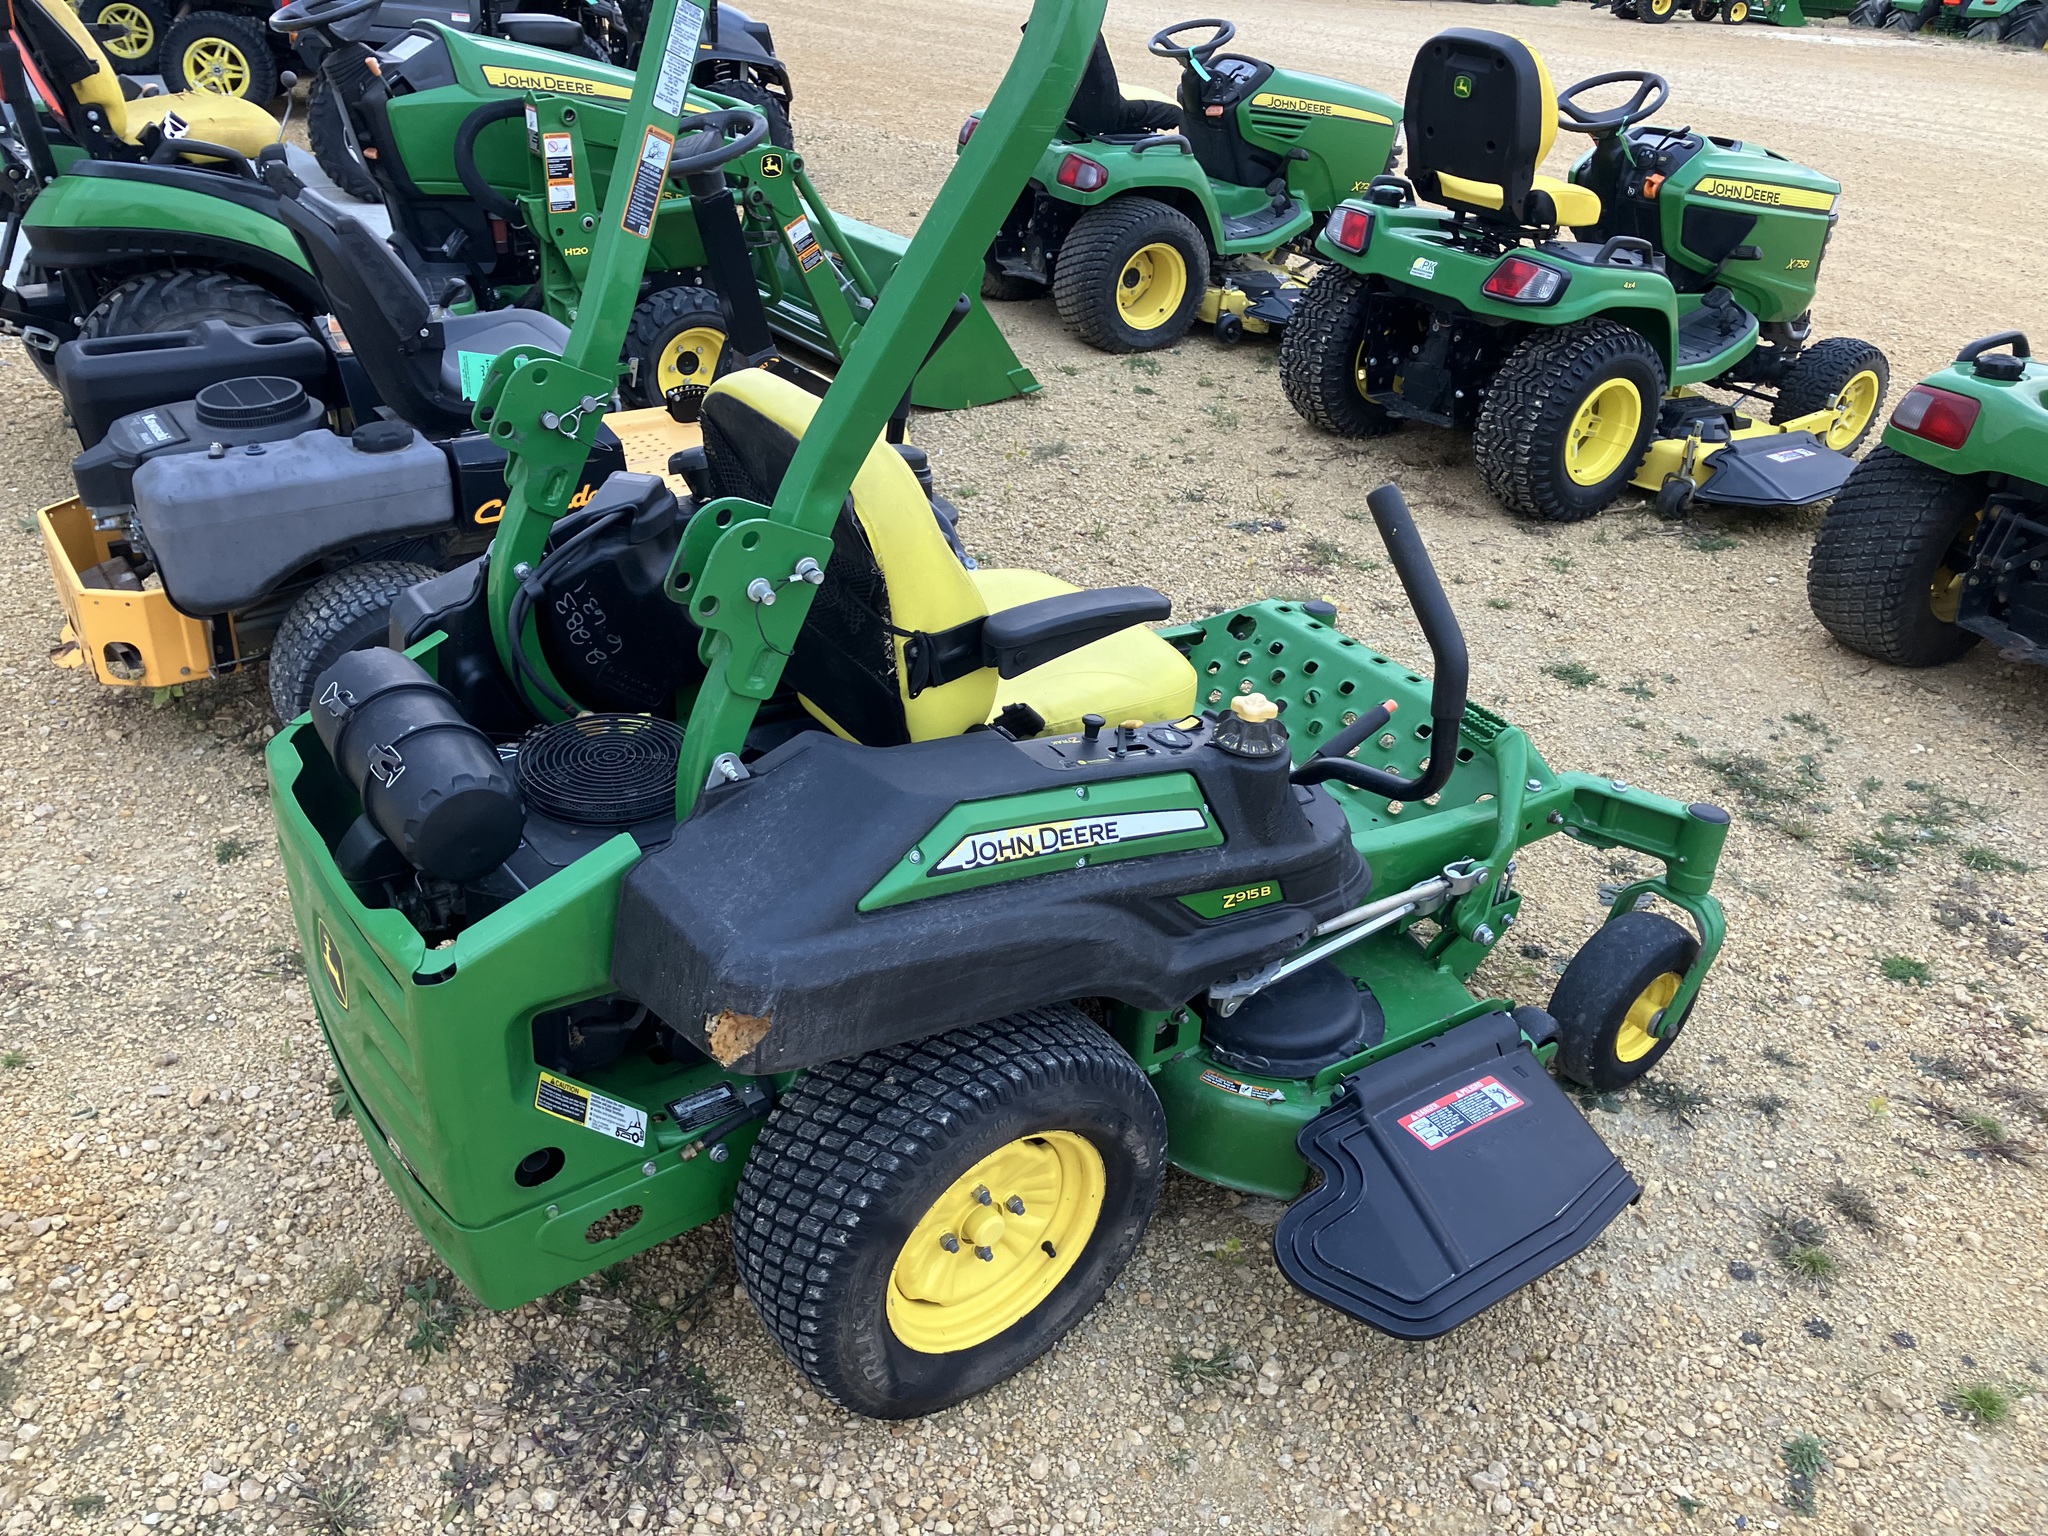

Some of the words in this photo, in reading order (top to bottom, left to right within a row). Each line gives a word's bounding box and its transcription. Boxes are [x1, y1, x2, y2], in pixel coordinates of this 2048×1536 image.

[500, 73, 541, 88] JOHN
[544, 76, 594, 94] DEERE
[1267, 97, 1297, 110] JOHN
[1299, 100, 1332, 115] DEERE
[1351, 181, 1370, 191] X72
[1708, 180, 1743, 198] JOHN
[1744, 185, 1780, 204] DEERE
[565, 247, 588, 256] H120
[1785, 258, 1810, 270] X758
[142, 413, 171, 441] Kawasaki
[964, 834, 1034, 865] JOHN
[1040, 821, 1119, 849] DEERE
[1223, 886, 1271, 909] Z915B
[555, 1080, 580, 1095] CAUTION
[1415, 1102, 1440, 1117] DANGER
